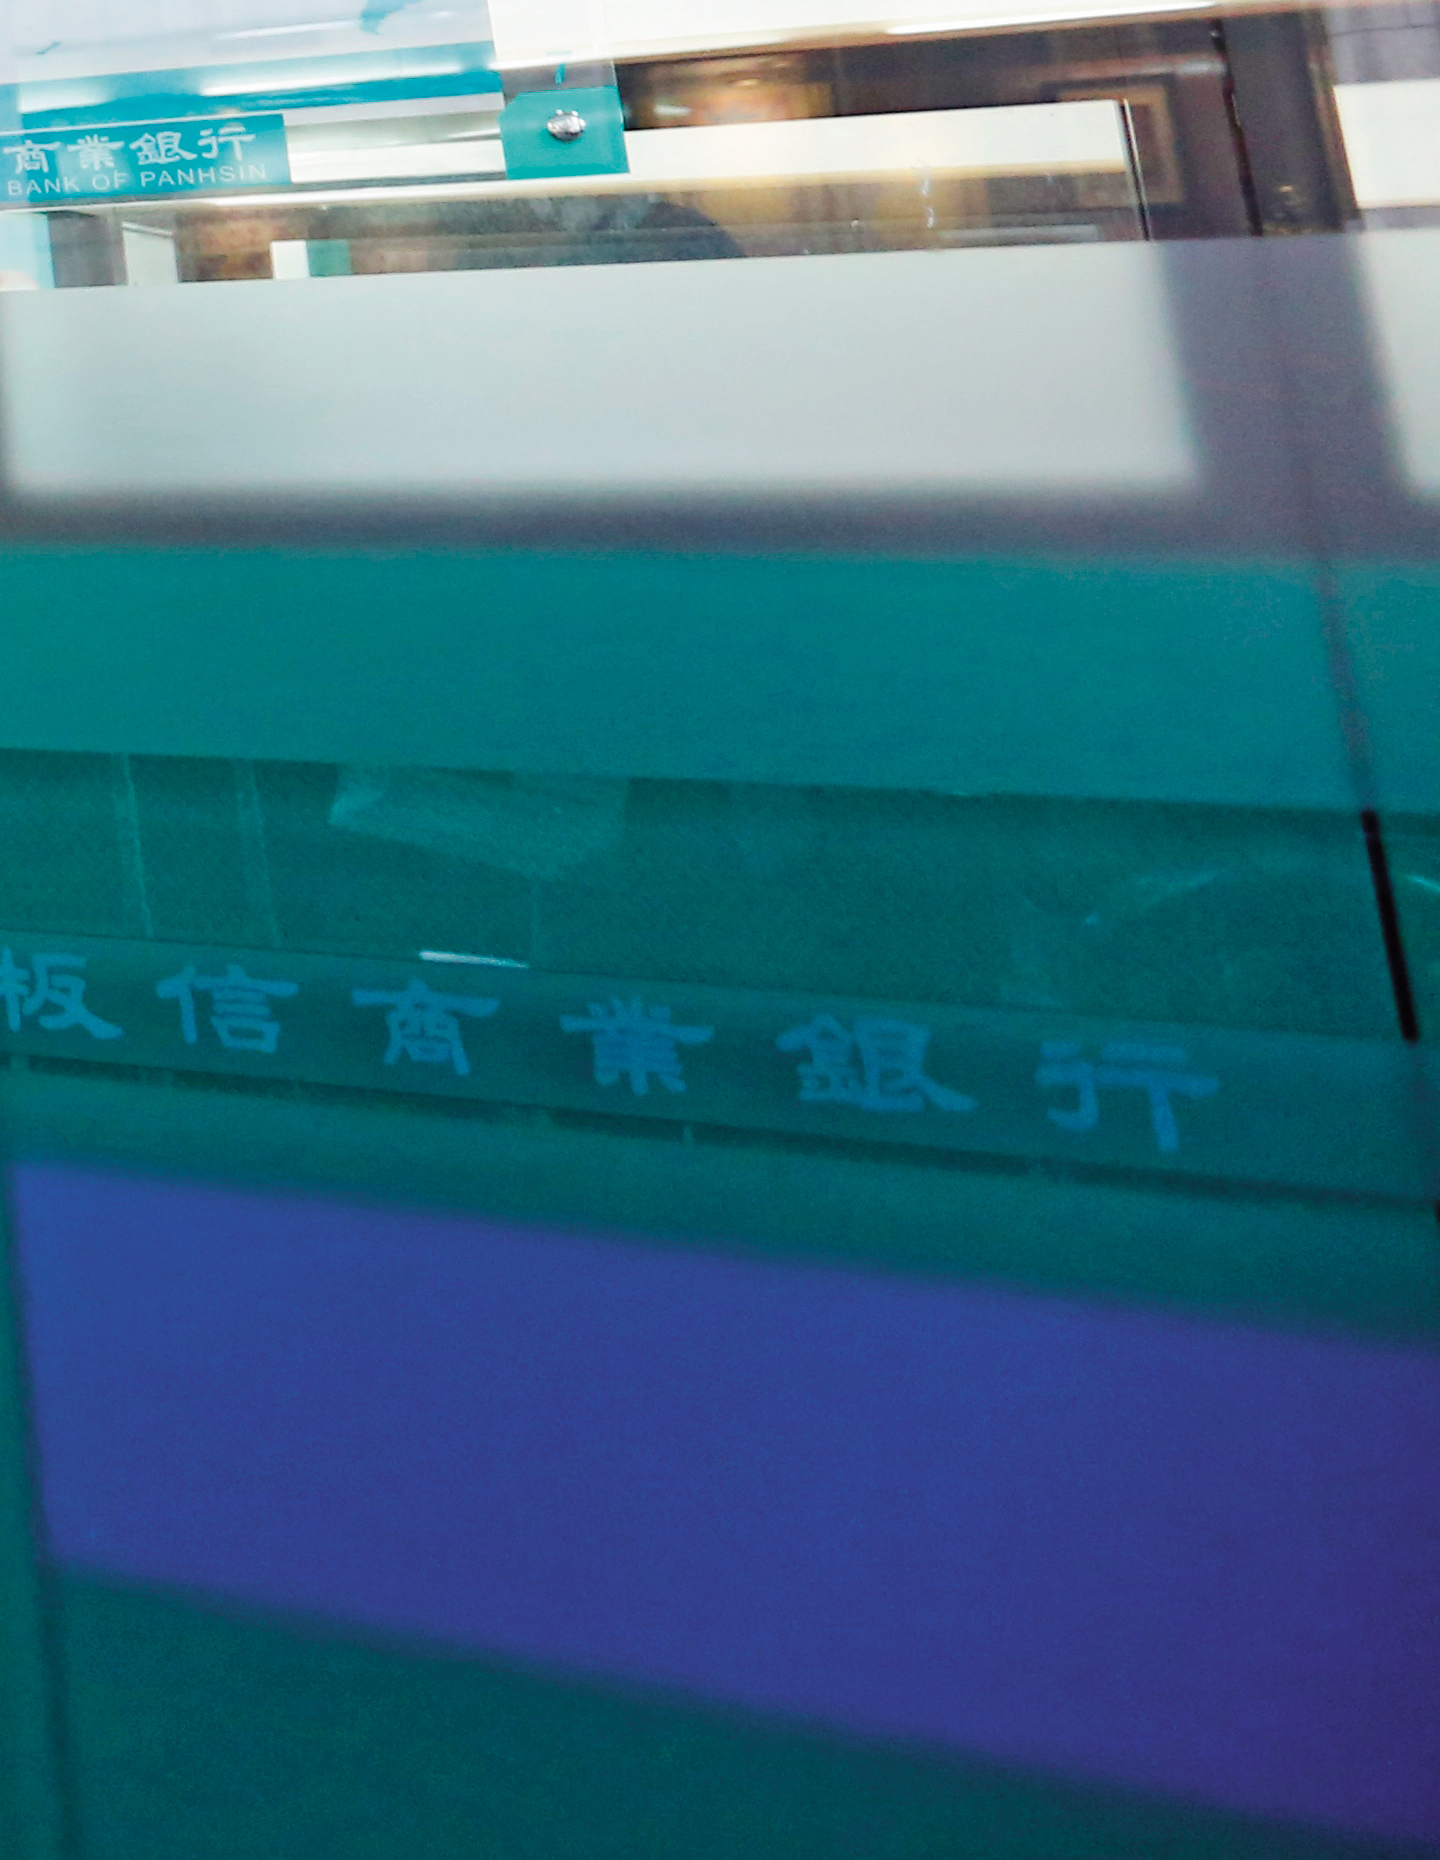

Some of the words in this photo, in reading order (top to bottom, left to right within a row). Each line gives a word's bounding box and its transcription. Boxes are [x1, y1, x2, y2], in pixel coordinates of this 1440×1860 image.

[7, 176, 80, 197] BANK
[92, 170, 126, 191] OF
[140, 164, 266, 188] PANHSIN
